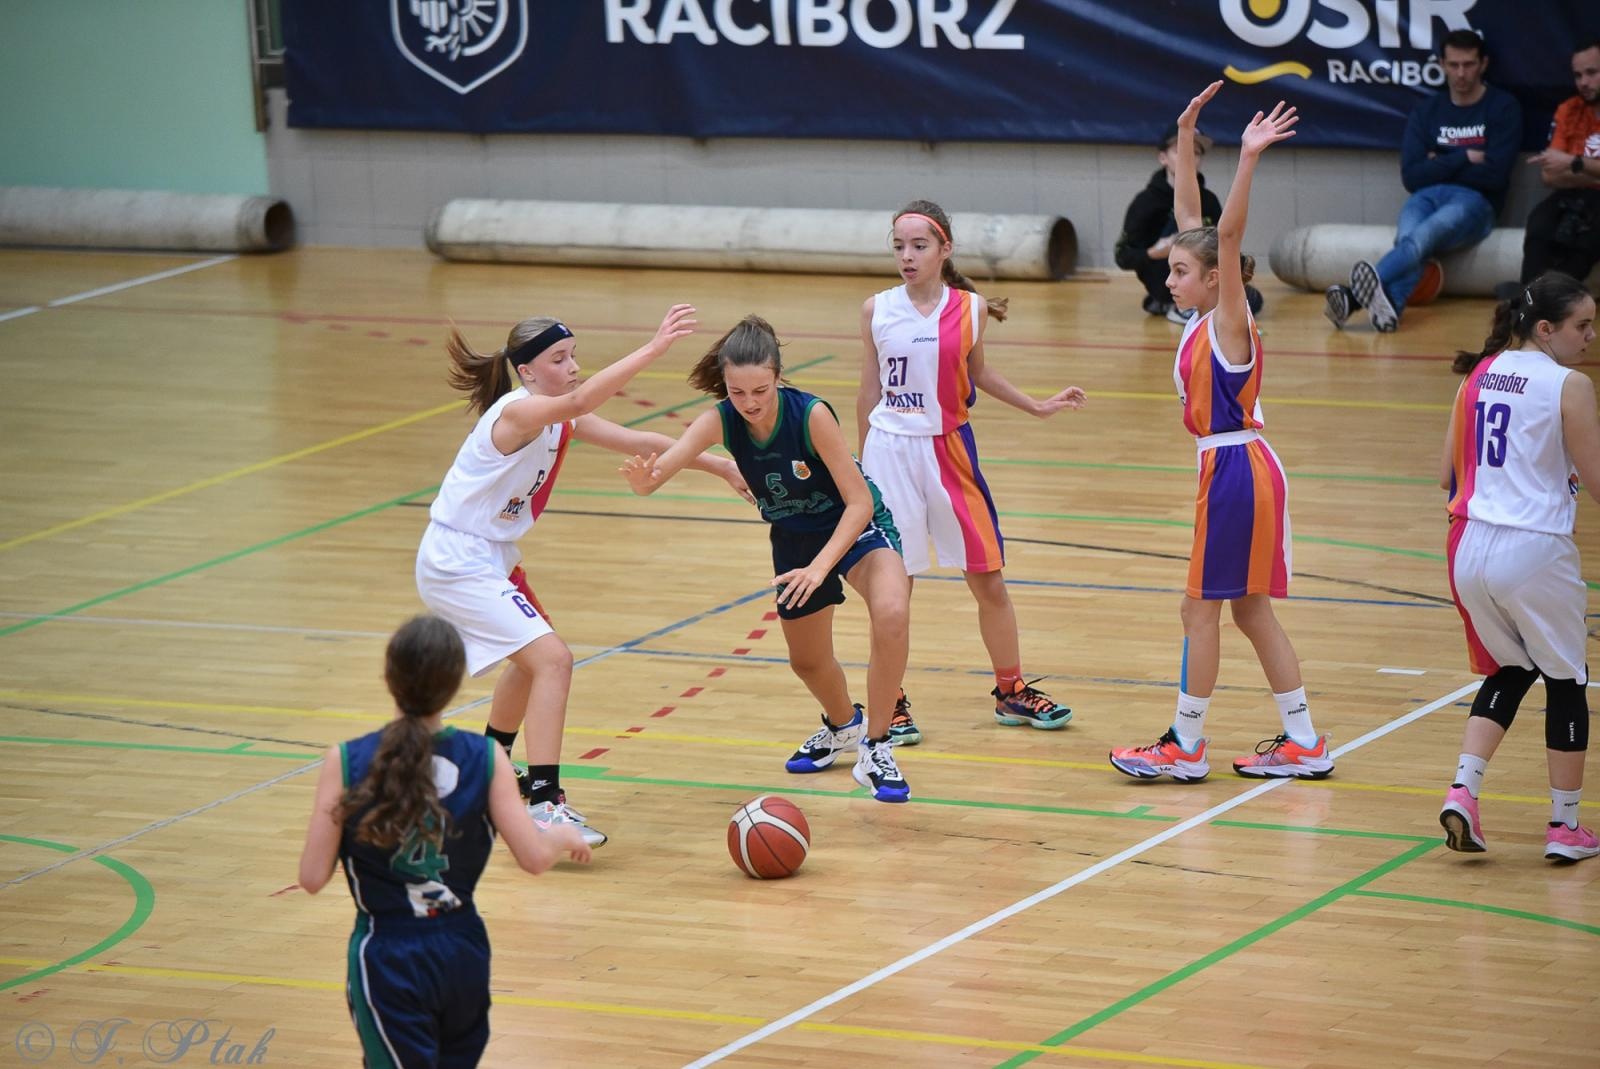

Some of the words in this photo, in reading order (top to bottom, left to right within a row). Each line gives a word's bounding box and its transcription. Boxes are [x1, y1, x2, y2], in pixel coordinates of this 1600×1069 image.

[1327, 54, 1446, 87] RACIBÓ
[1439, 124, 1486, 139] TOMMY
[887, 356, 908, 387] 27
[1474, 401, 1511, 468] 13
[765, 472, 788, 498] 5
[511, 595, 537, 618] 6
[390, 809, 450, 884] 4
